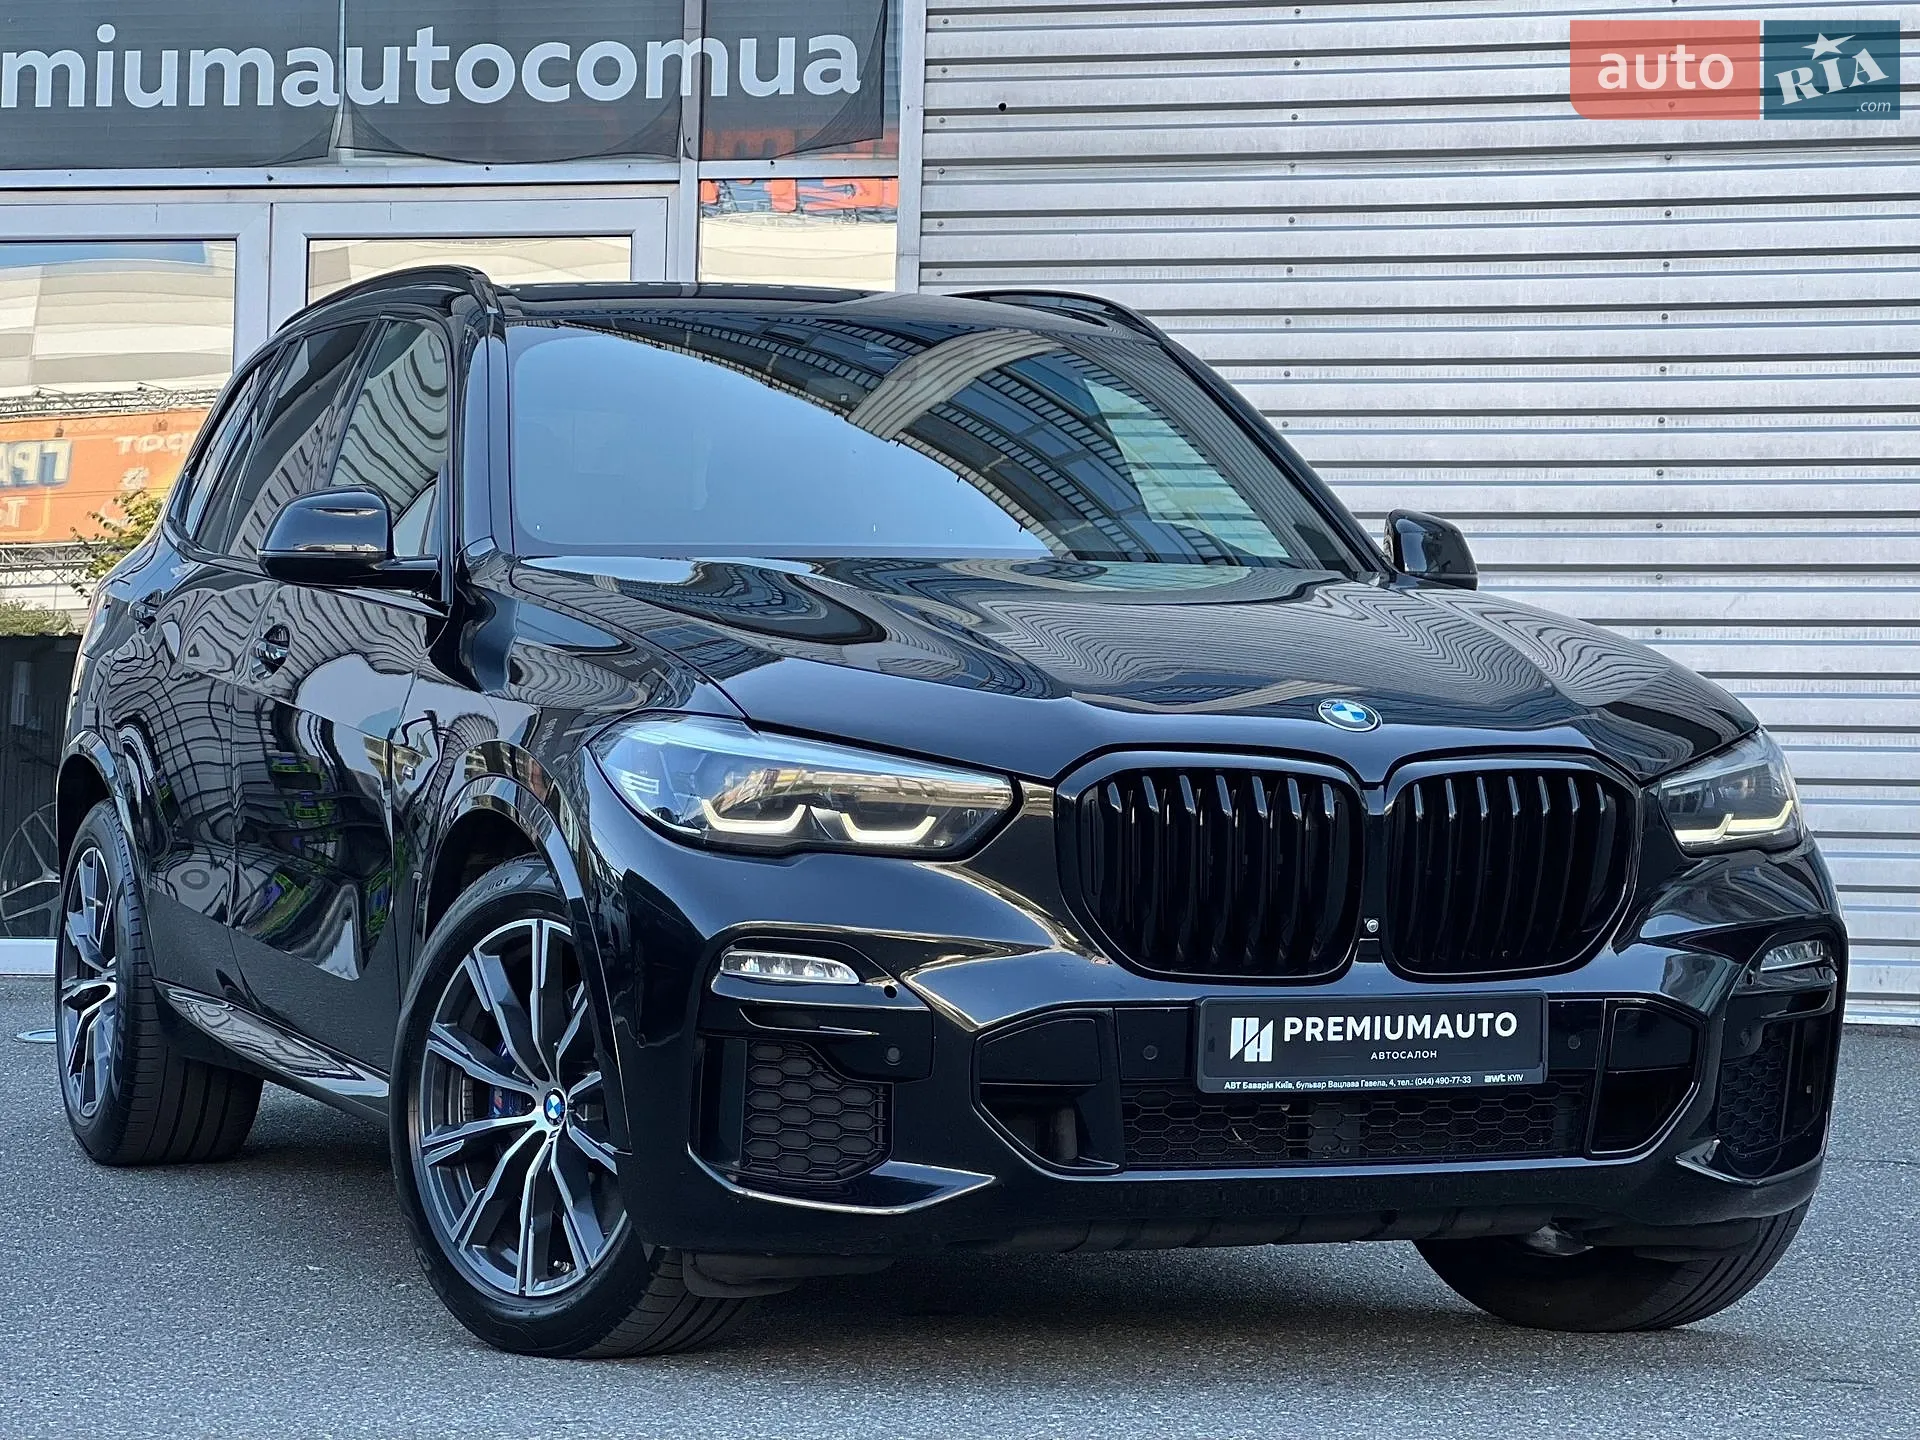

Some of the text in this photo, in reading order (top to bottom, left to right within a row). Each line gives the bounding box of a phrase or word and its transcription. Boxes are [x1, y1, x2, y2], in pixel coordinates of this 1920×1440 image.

[1284, 1011, 1518, 1043] PREMIUMAUTO
[1370, 1049, 1438, 1061] АВТОСАЛОН
[1224, 1081, 1242, 1090] АВТ
[1242, 1080, 1274, 1091] Баварія
[1296, 1080, 1327, 1092] бульвар
[1328, 1079, 1360, 1090] Вацлава
[1361, 1078, 1388, 1090] Гавела,
[1389, 1078, 1396, 1089] 4,
[1415, 1076, 1435, 1088] (044)
[1435, 1075, 1472, 1086] 490-77-33
[1507, 1073, 1524, 1083] KYIV
